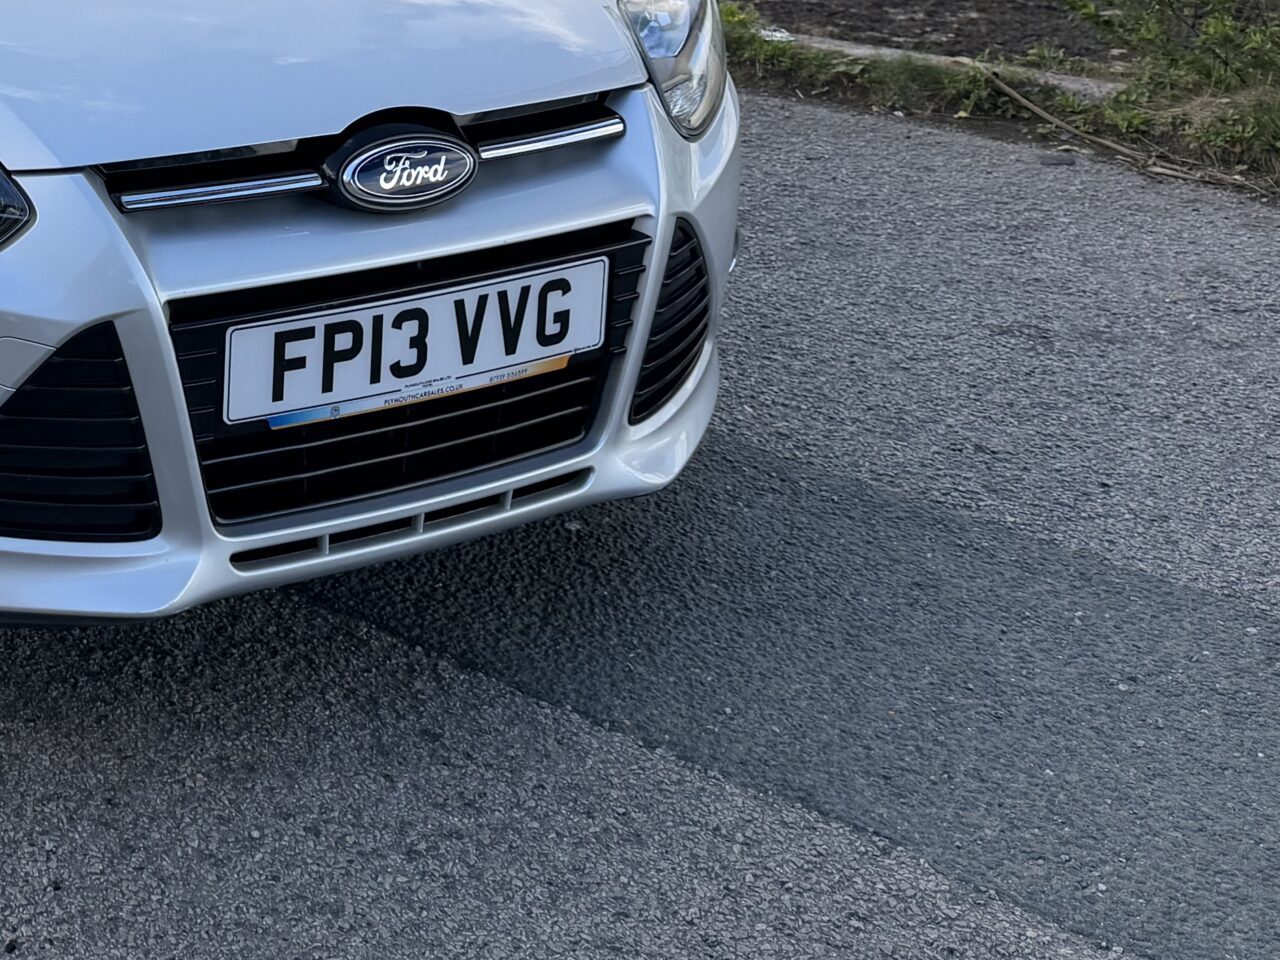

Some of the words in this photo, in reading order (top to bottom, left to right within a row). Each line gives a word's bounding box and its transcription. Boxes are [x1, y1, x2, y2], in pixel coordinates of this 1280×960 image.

[379, 150, 449, 190] Ford
[270, 306, 430, 404] FP13
[453, 277, 573, 366] VVG
